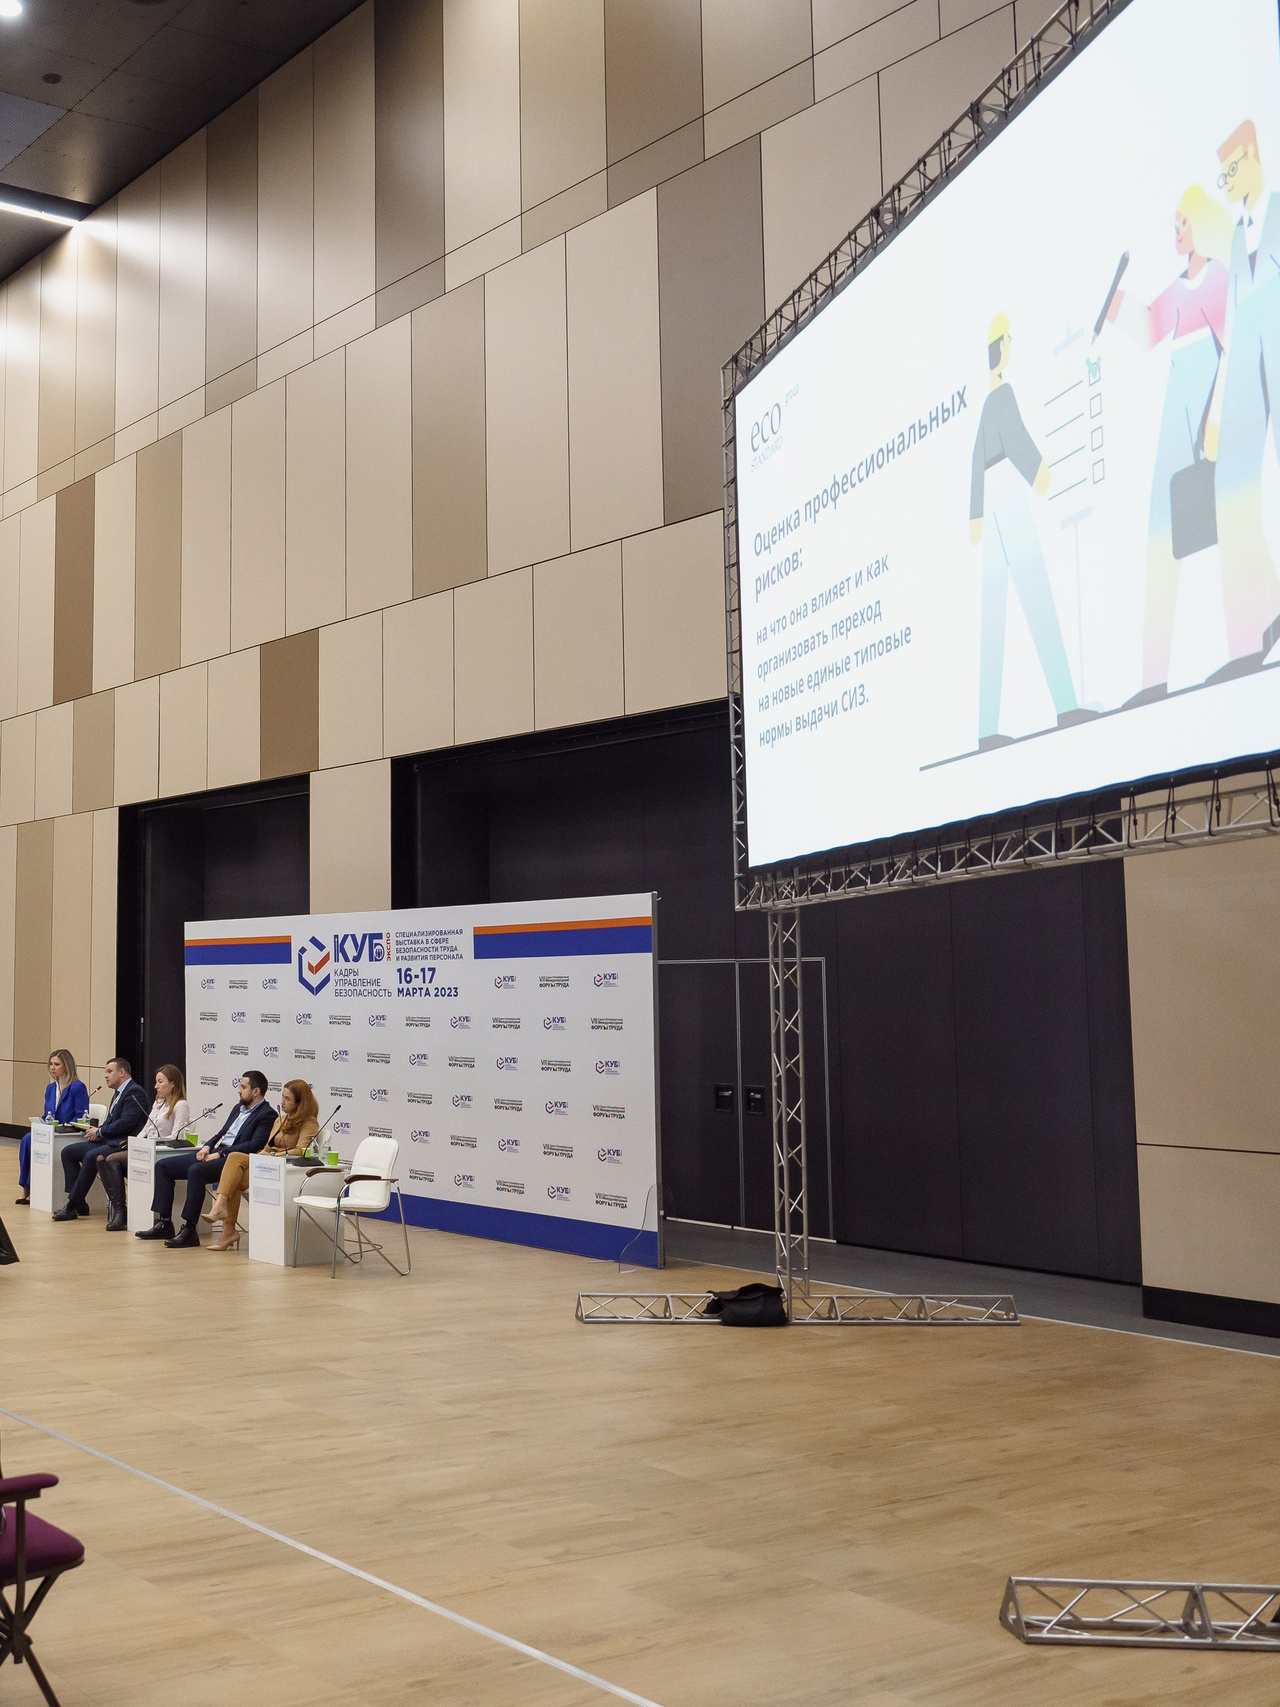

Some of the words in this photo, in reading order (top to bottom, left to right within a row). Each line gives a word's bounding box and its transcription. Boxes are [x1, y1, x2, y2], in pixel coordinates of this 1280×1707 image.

[751, 402, 781, 453] eco
[754, 506, 801, 557] Оценка
[804, 385, 968, 523] профессиональных
[754, 549, 803, 602] рисков:
[756, 626, 767, 645] на
[769, 617, 787, 636] что
[790, 606, 808, 627] она
[811, 578, 851, 614] влияет
[855, 571, 863, 589] и
[867, 555, 890, 582] как
[757, 629, 828, 679] организовать
[831, 599, 882, 642] переход
[758, 693, 770, 713] на
[772, 671, 804, 705] новые
[807, 654, 851, 693] единые
[854, 625, 912, 668] типовые
[759, 719, 793, 747] нормы
[795, 697, 838, 733] выдачи
[841, 683, 869, 716] СИЗ.
[334, 932, 385, 963] КУБ
[395, 929, 463, 938] СПЕЦИАЛИЗИРОВАННАЯ
[334, 968, 359, 977] КАДРЫ
[430, 953, 463, 961] ПЕРСОНАЛА
[334, 978, 381, 987] УПРАВЛЕНИЕ
[397, 967, 436, 984] 16-17
[334, 989, 392, 997] БЕЗОПАСНОСТЬ
[397, 987, 431, 997] МАРТА
[434, 987, 458, 997] 2023
